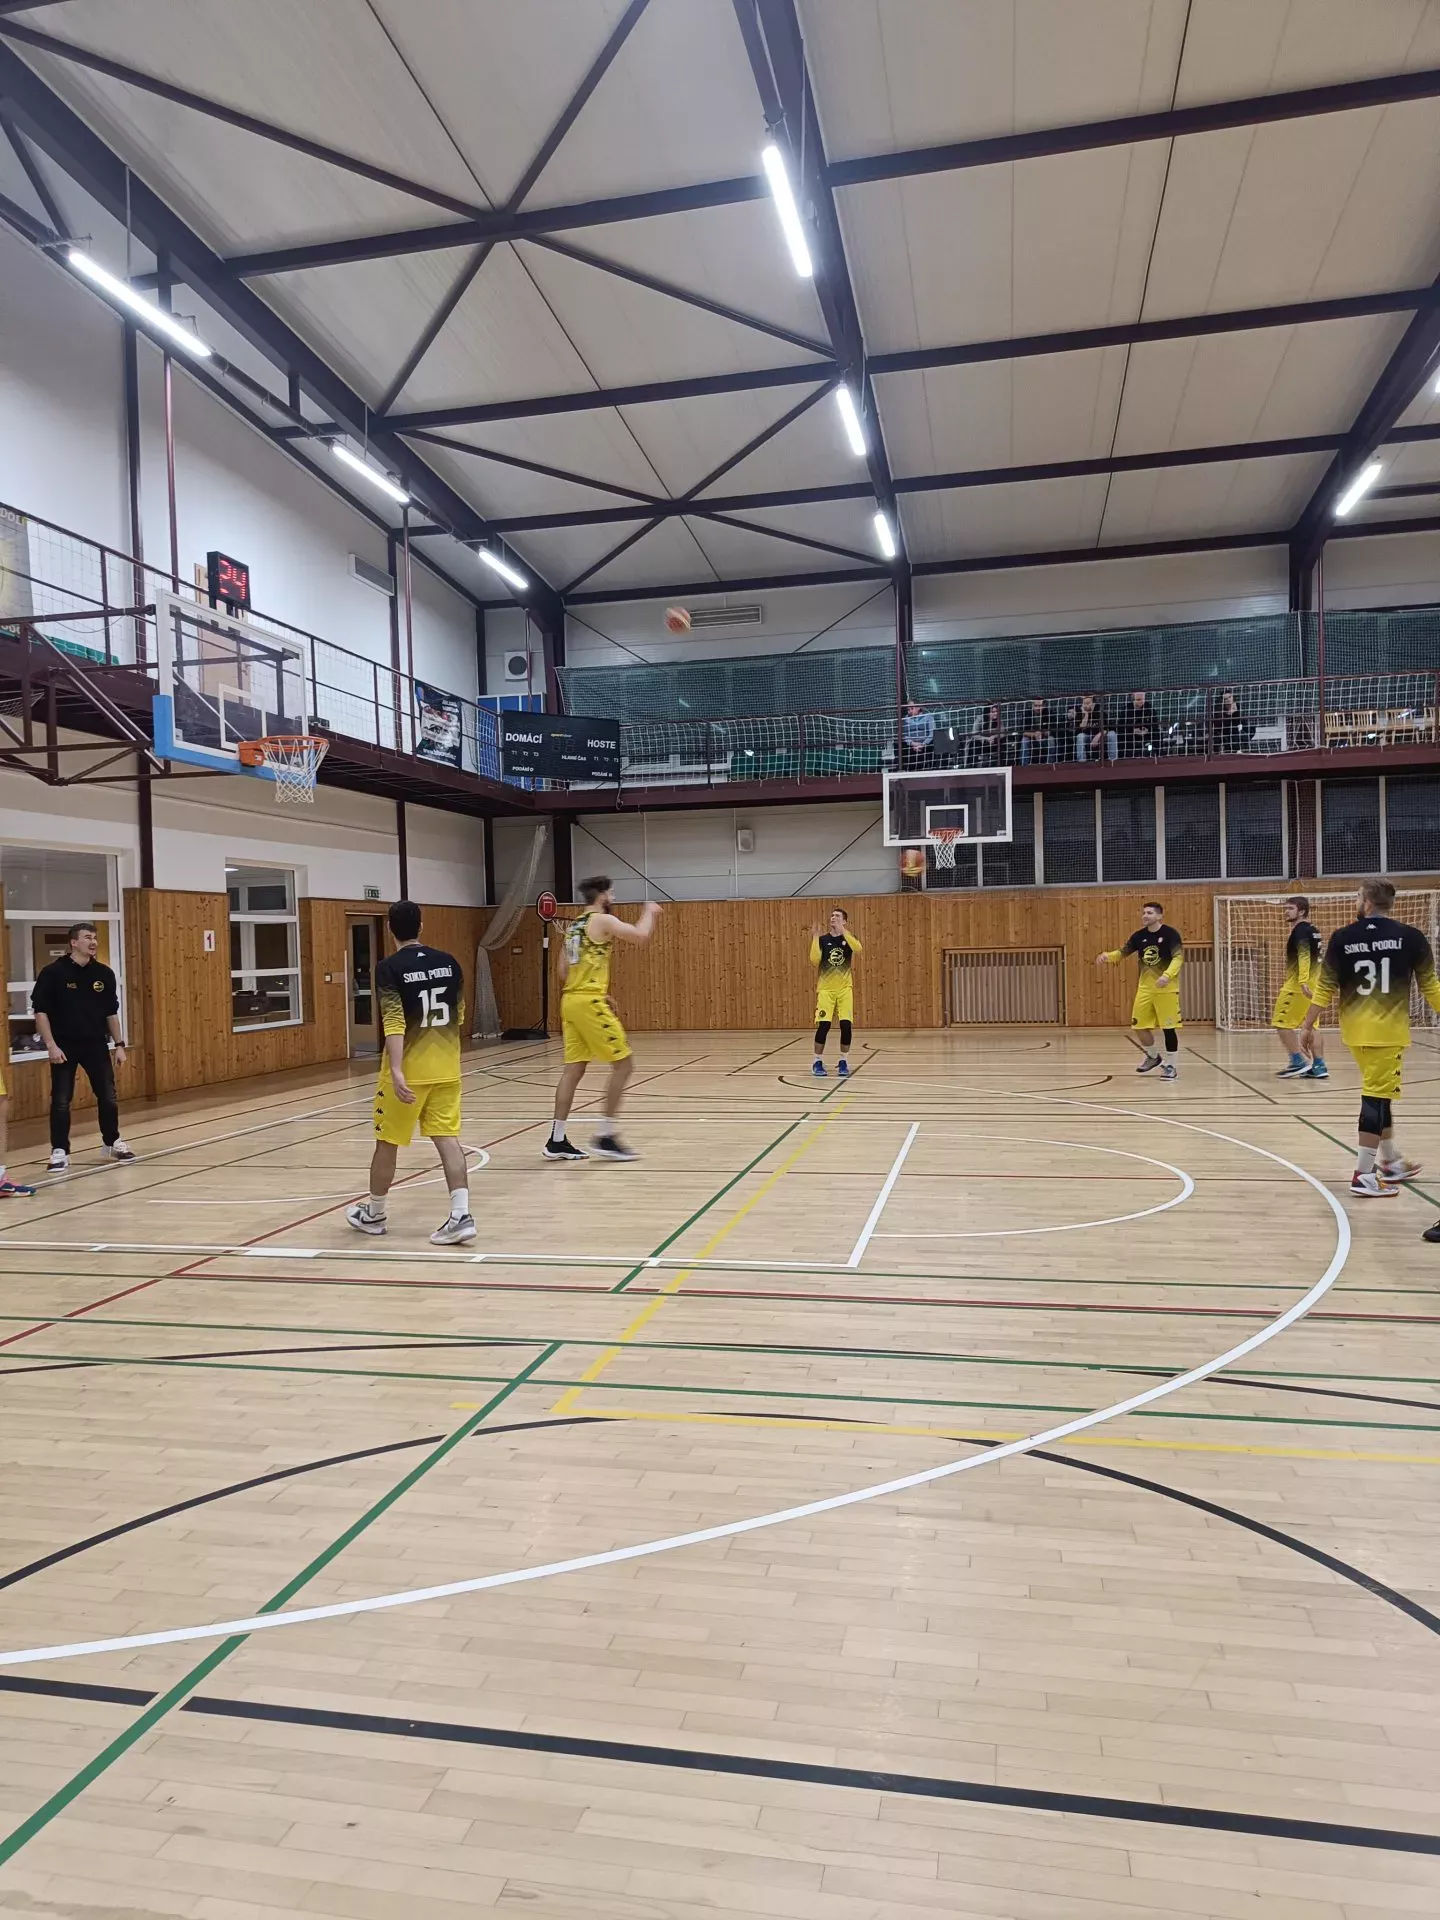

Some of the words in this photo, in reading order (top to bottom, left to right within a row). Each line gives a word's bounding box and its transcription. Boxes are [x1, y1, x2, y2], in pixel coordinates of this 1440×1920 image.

[219, 560, 247, 599] 24
[505, 733, 543, 744] DOMÁCÍ
[587, 739, 617, 749] HOSTE
[1344, 943, 1371, 955] SOKOL
[1372, 937, 1403, 951] PODOLÍ
[403, 971, 428, 983] SOKOL
[1353, 957, 1390, 996] 31
[417, 986, 450, 1028] 15
